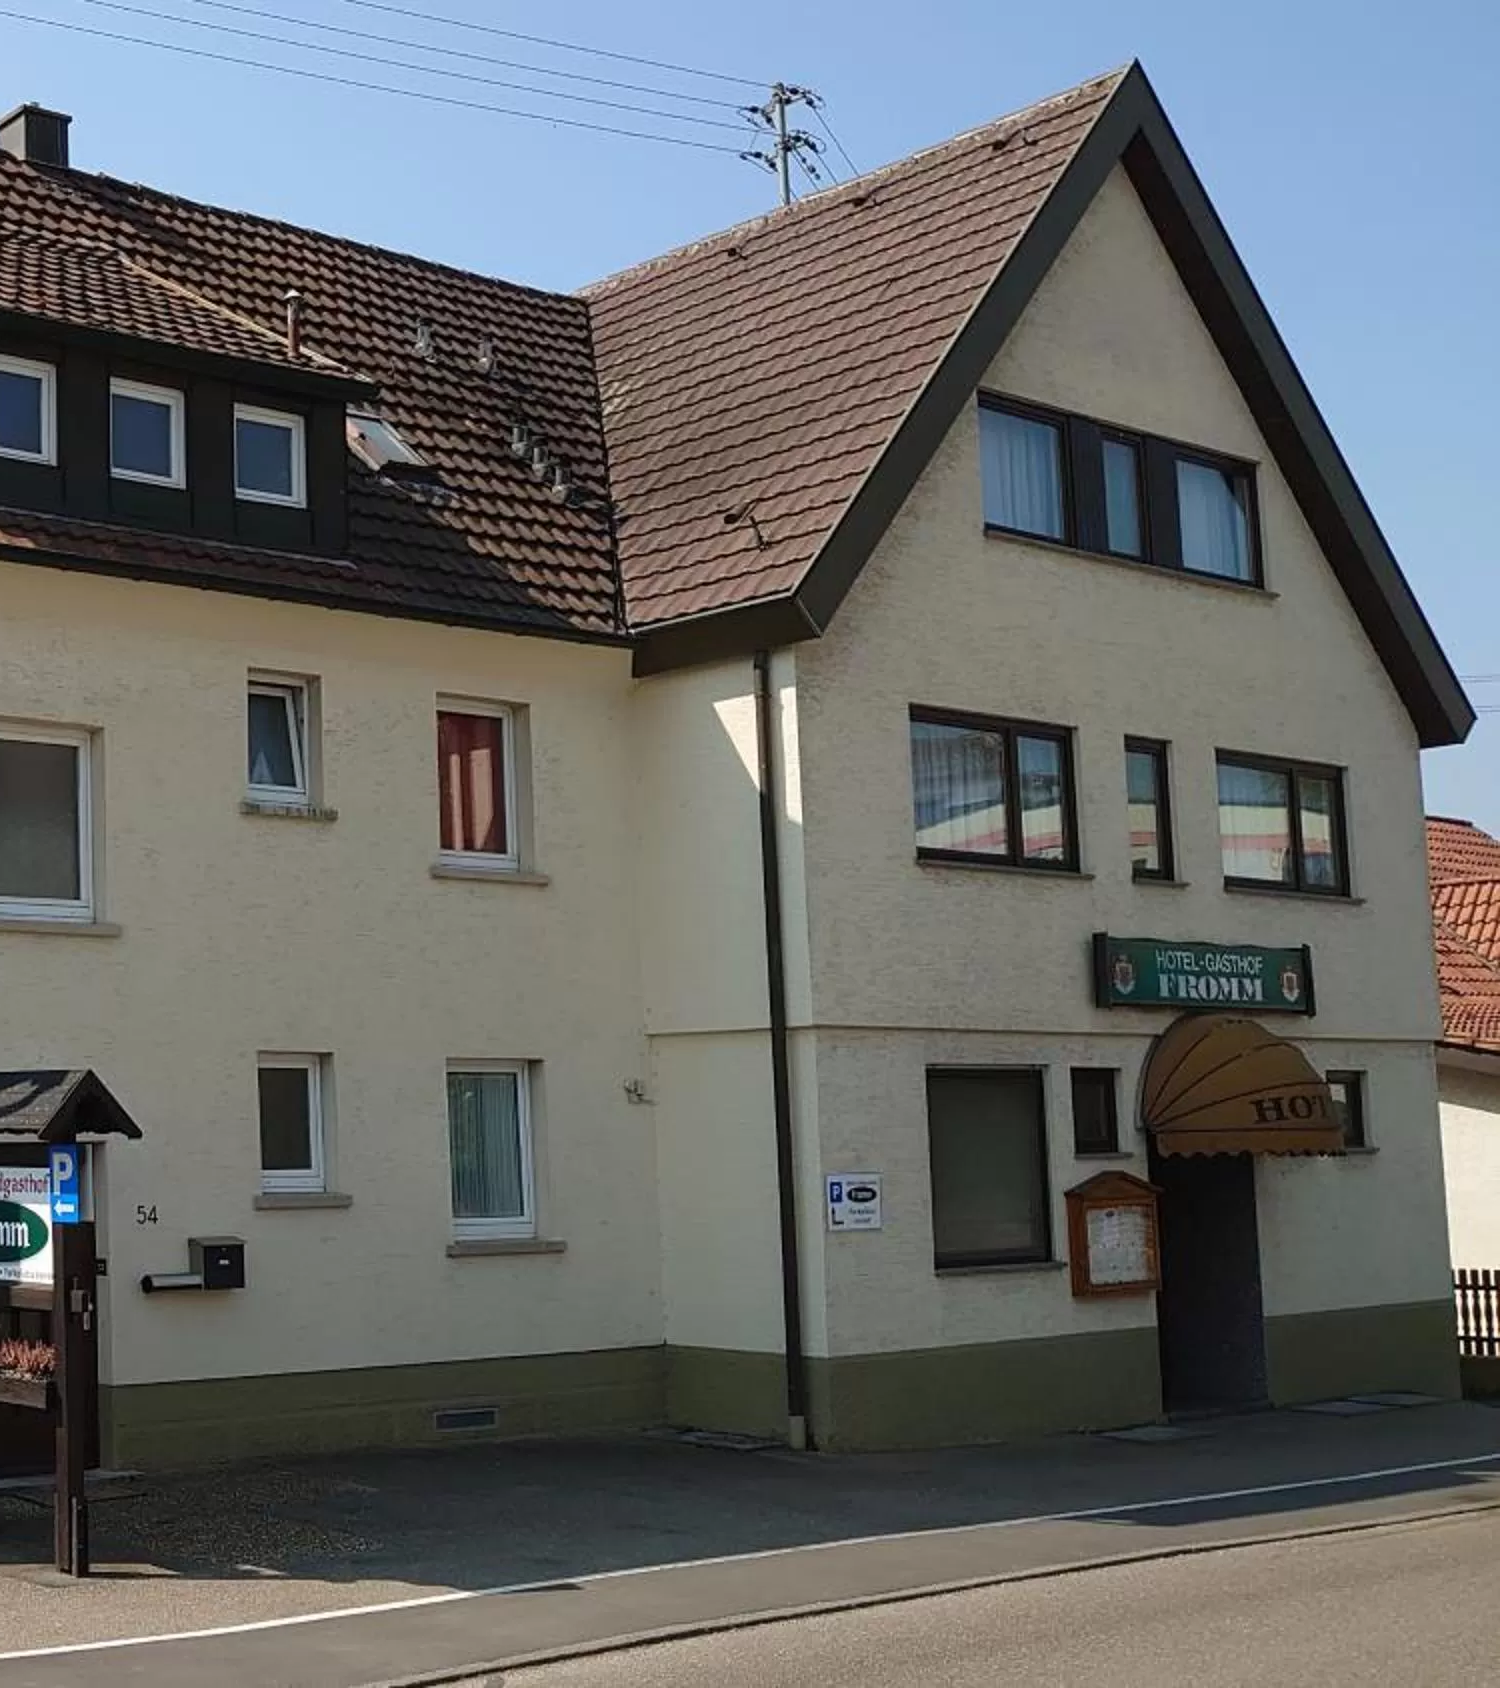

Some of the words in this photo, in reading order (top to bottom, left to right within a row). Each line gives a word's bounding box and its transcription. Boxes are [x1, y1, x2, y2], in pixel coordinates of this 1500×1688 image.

[1155, 948, 1264, 975] HOTEL-GASTHOF
[1157, 973, 1264, 1002] FROMM
[52, 1152, 74, 1195] P
[135, 1204, 159, 1225] 54
